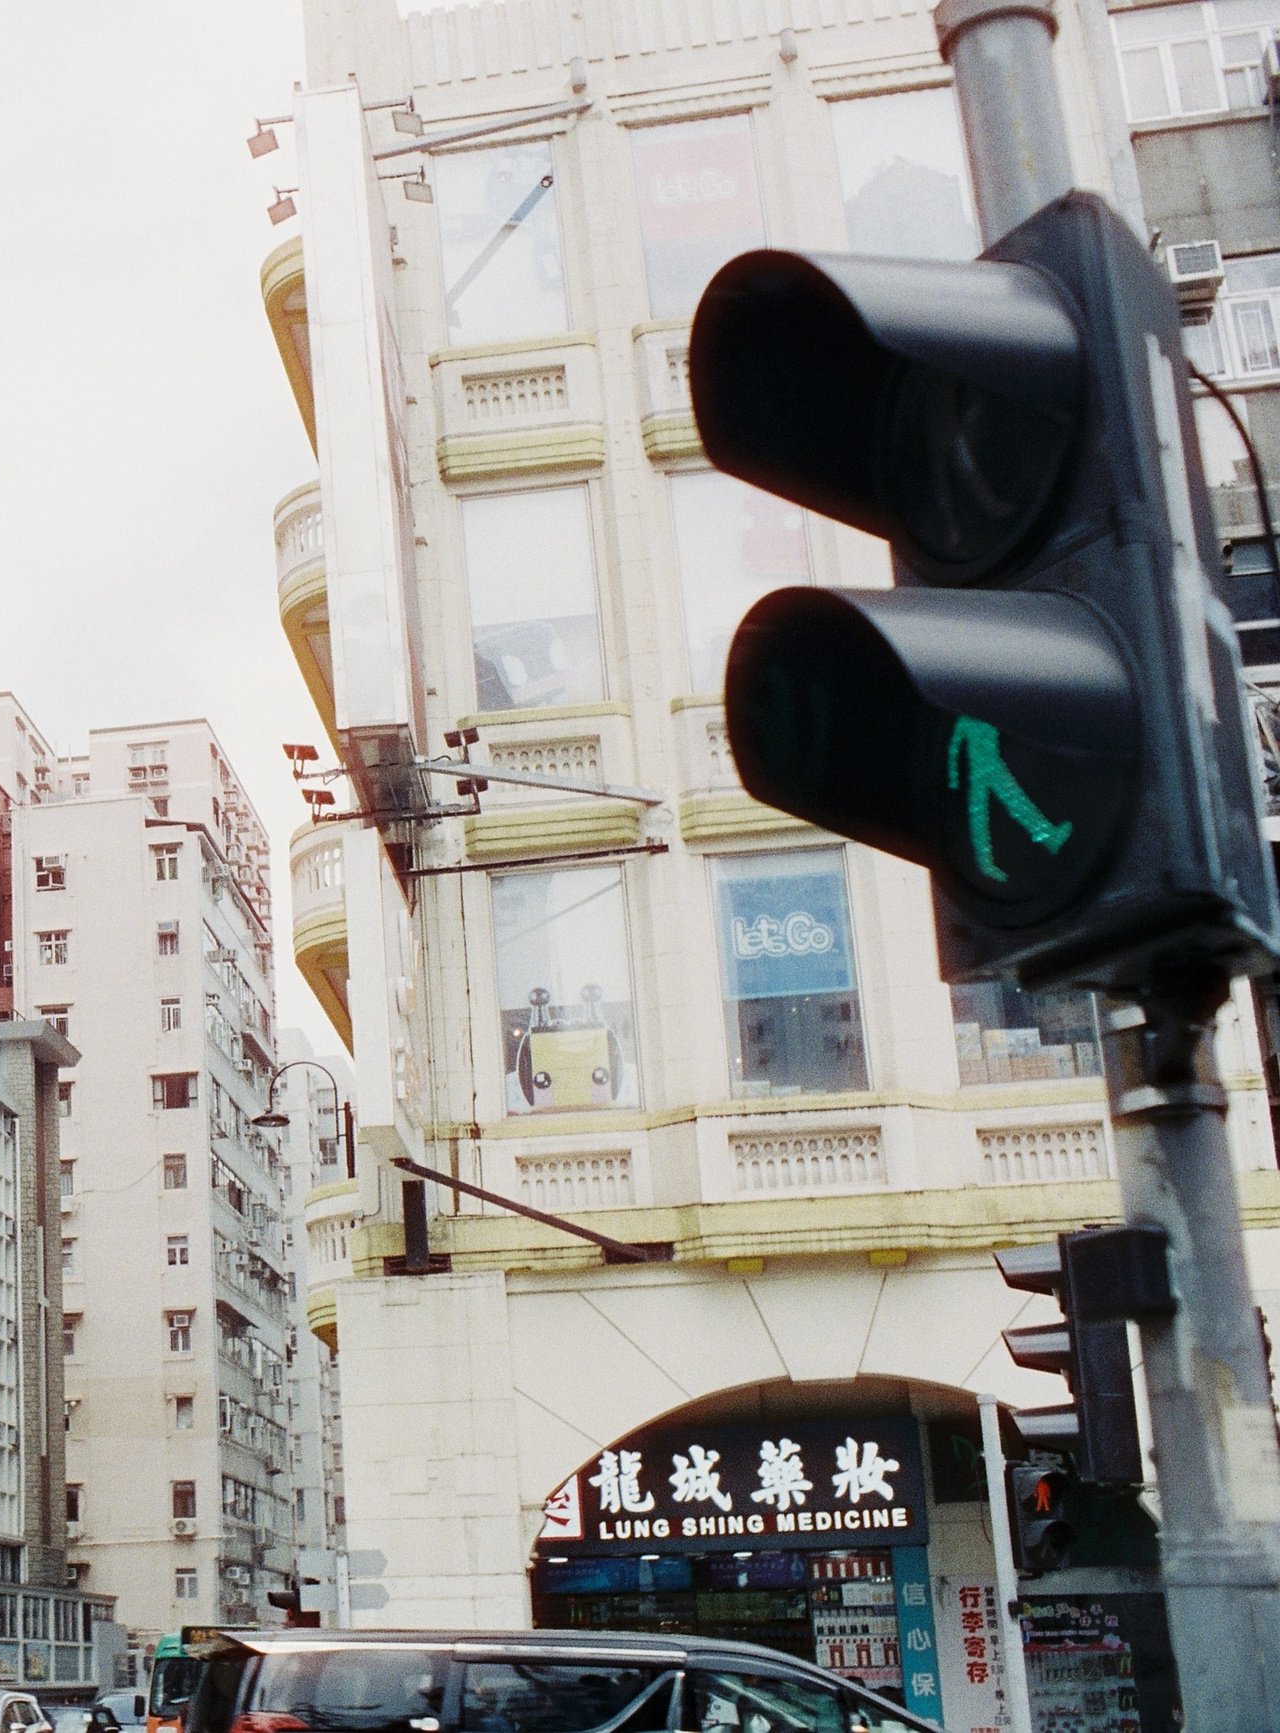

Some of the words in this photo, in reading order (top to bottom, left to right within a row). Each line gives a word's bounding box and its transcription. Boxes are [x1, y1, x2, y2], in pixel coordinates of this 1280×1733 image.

[588, 1436, 900, 1514] 龍城藥妝
[599, 1518, 671, 1540] LUNG
[681, 1514, 765, 1537] SHING
[776, 1507, 908, 1533] MEDICINE
[902, 1582, 939, 1728] 信心保
[958, 1586, 989, 1684] 行李寄存
